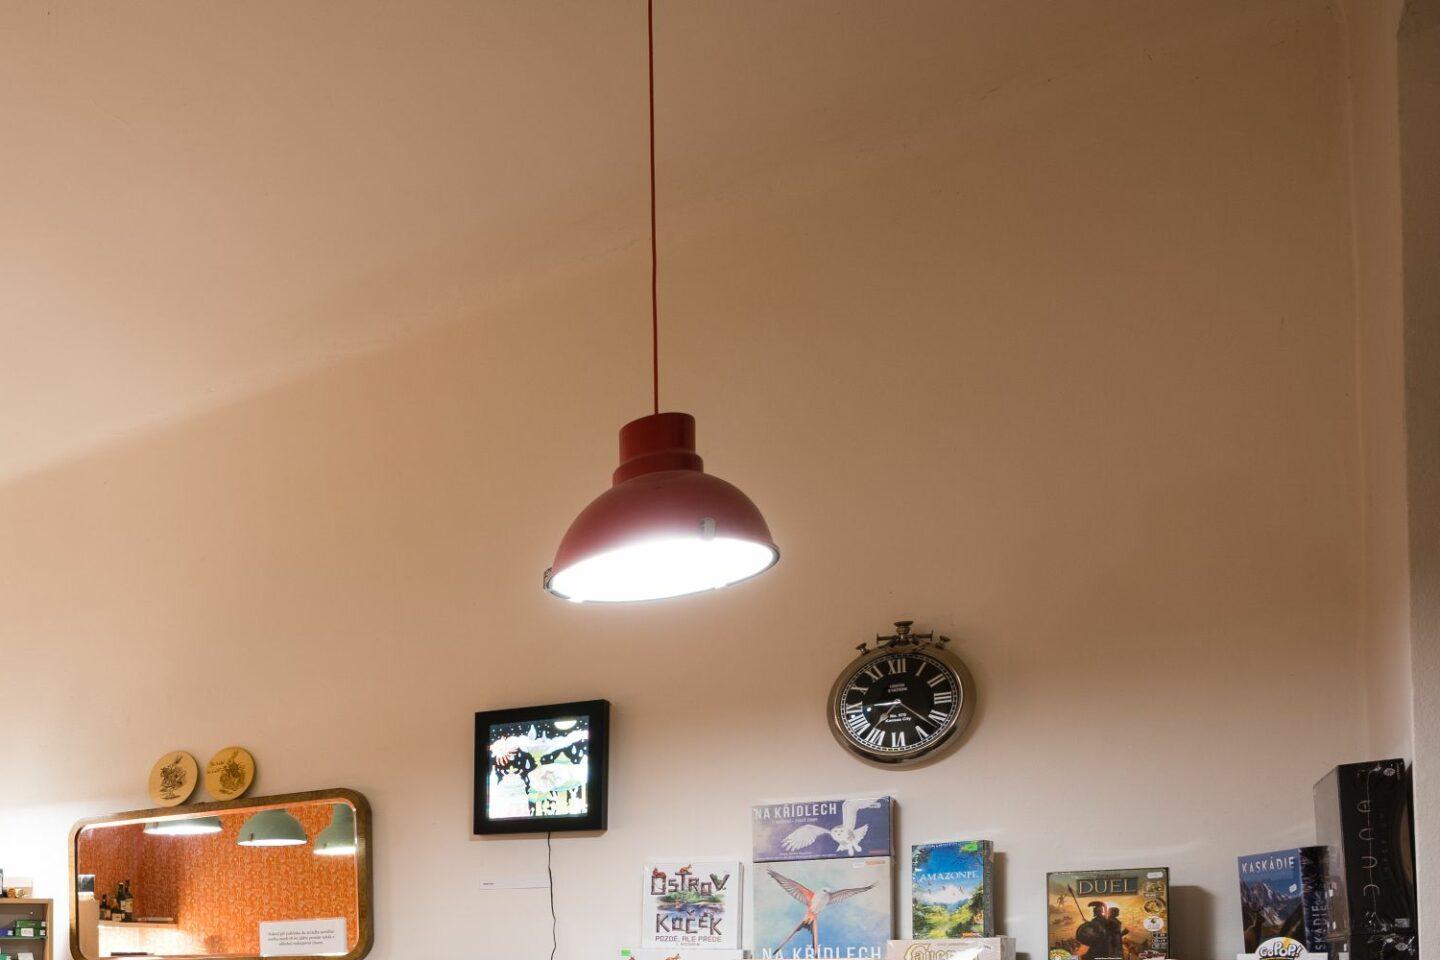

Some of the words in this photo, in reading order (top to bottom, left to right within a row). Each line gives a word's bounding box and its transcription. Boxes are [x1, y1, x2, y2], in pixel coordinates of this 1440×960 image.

[887, 658, 907, 675] XII
[934, 691, 952, 704] III
[754, 807, 771, 819] NA
[774, 802, 837, 818] KŘÍDLECH
[1242, 855, 1295, 873] KASKÁDIE
[1078, 878, 1137, 896] DUEL
[656, 909, 722, 935] KOČEK
[762, 948, 783, 960] NA
[793, 944, 882, 960] KŘÍDLECH
